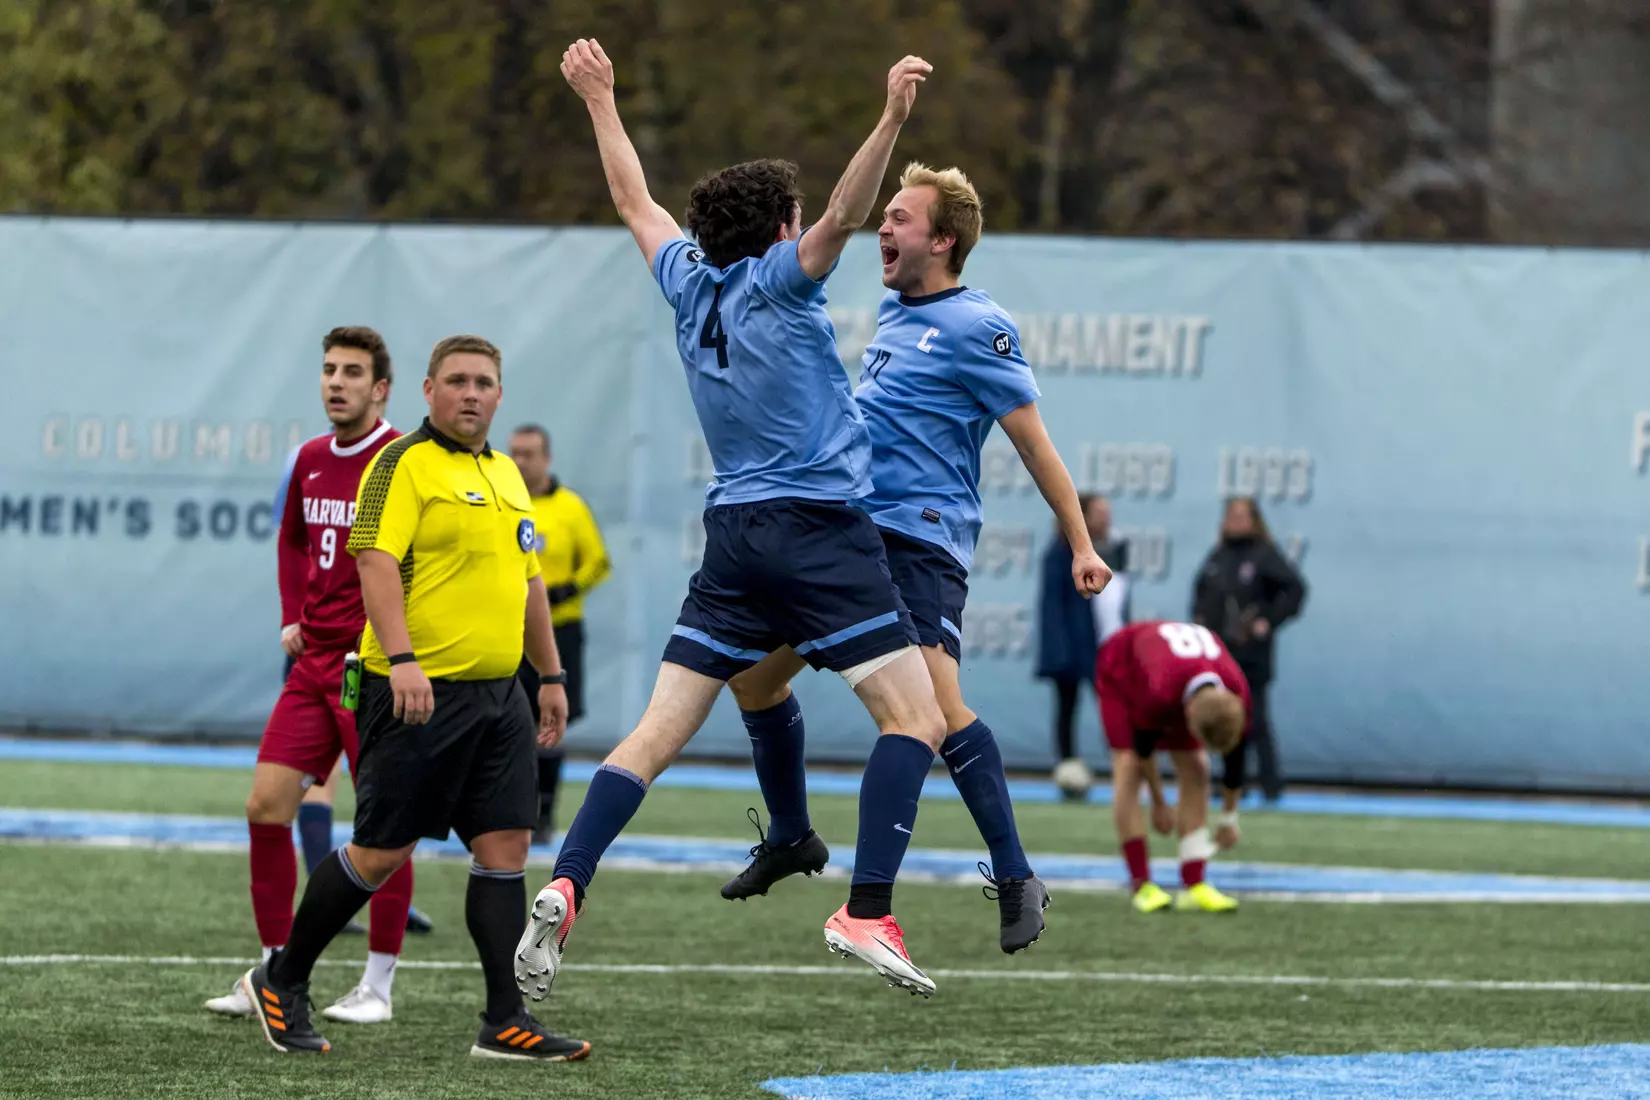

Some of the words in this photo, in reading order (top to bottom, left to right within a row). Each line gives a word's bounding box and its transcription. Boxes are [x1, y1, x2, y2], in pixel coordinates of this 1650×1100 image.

[700, 283, 730, 369] 4
[917, 327, 940, 354] C
[995, 335, 1011, 353] 67
[1018, 312, 1212, 375] NAMENT
[867, 349, 892, 380] 17
[42, 415, 302, 463] COLUMBI
[0, 495, 152, 538] MEN'S
[175, 500, 274, 542] SOC
[303, 497, 358, 528] HARVAR
[318, 527, 337, 570] 9
